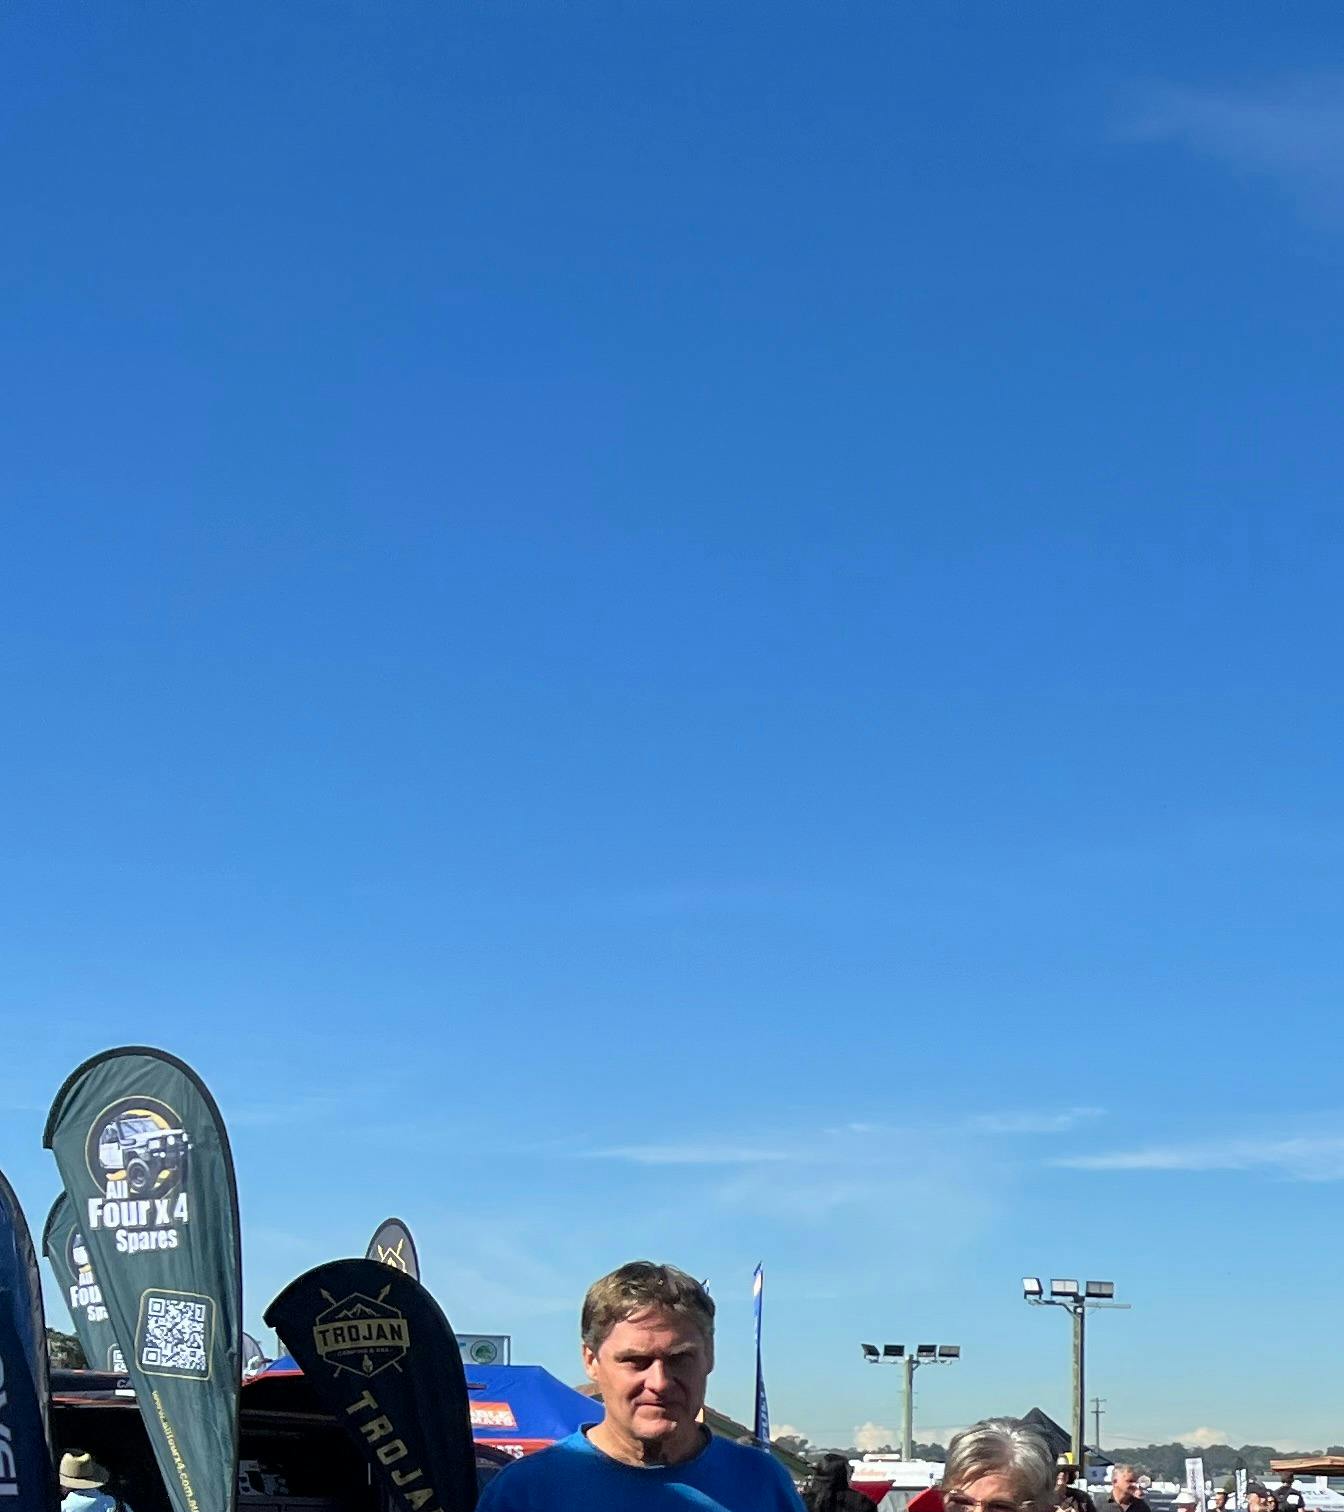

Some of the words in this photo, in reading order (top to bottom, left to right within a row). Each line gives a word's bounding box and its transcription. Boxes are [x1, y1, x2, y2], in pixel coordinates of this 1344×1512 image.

[106, 1180, 129, 1199] All
[88, 1198, 150, 1229] Four
[155, 1199, 171, 1225] x
[173, 1192, 189, 1223] 4
[115, 1228, 179, 1254] Spares
[69, 1285, 103, 1309] Fou
[317, 1323, 404, 1347] TROJAN
